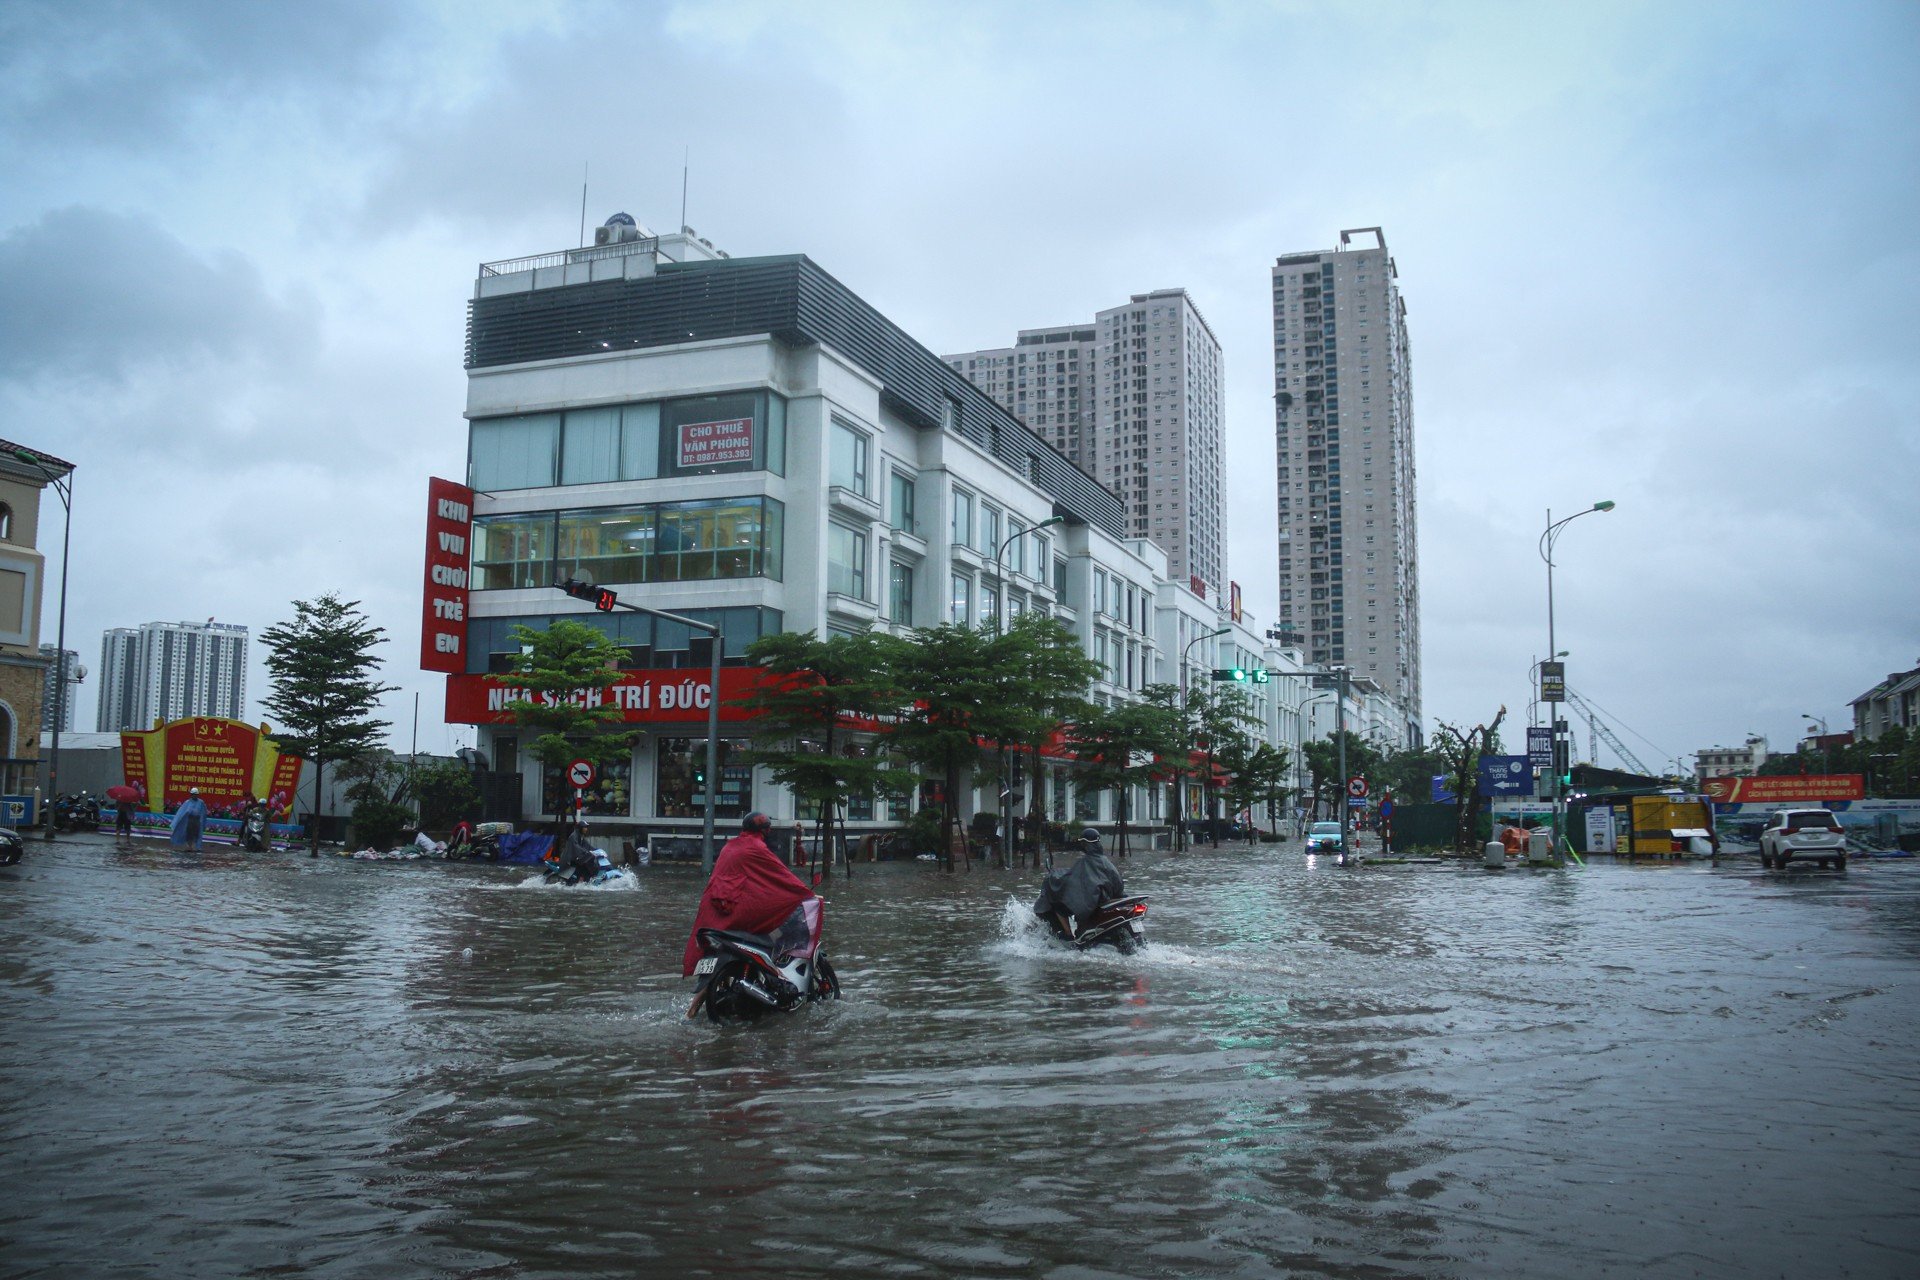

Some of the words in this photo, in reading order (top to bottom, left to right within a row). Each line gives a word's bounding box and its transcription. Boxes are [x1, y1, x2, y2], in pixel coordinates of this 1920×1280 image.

[690, 426, 712, 438] CHO
[715, 421, 744, 434] THUÊ
[684, 440, 707, 452] VĂN
[710, 436, 749, 449] PHÒNG
[697, 449, 750, 462] 0987.953.393
[437, 498, 469, 524] KHU
[438, 532, 465, 556] VUI
[431, 564, 467, 589] CHƠI
[433, 596, 464, 622] TRẺ
[435, 633, 460, 654] EM
[612, 680, 650, 709] TRÍ
[658, 678, 711, 710] ĐỨC
[1529, 737, 1553, 752] HOTEL
